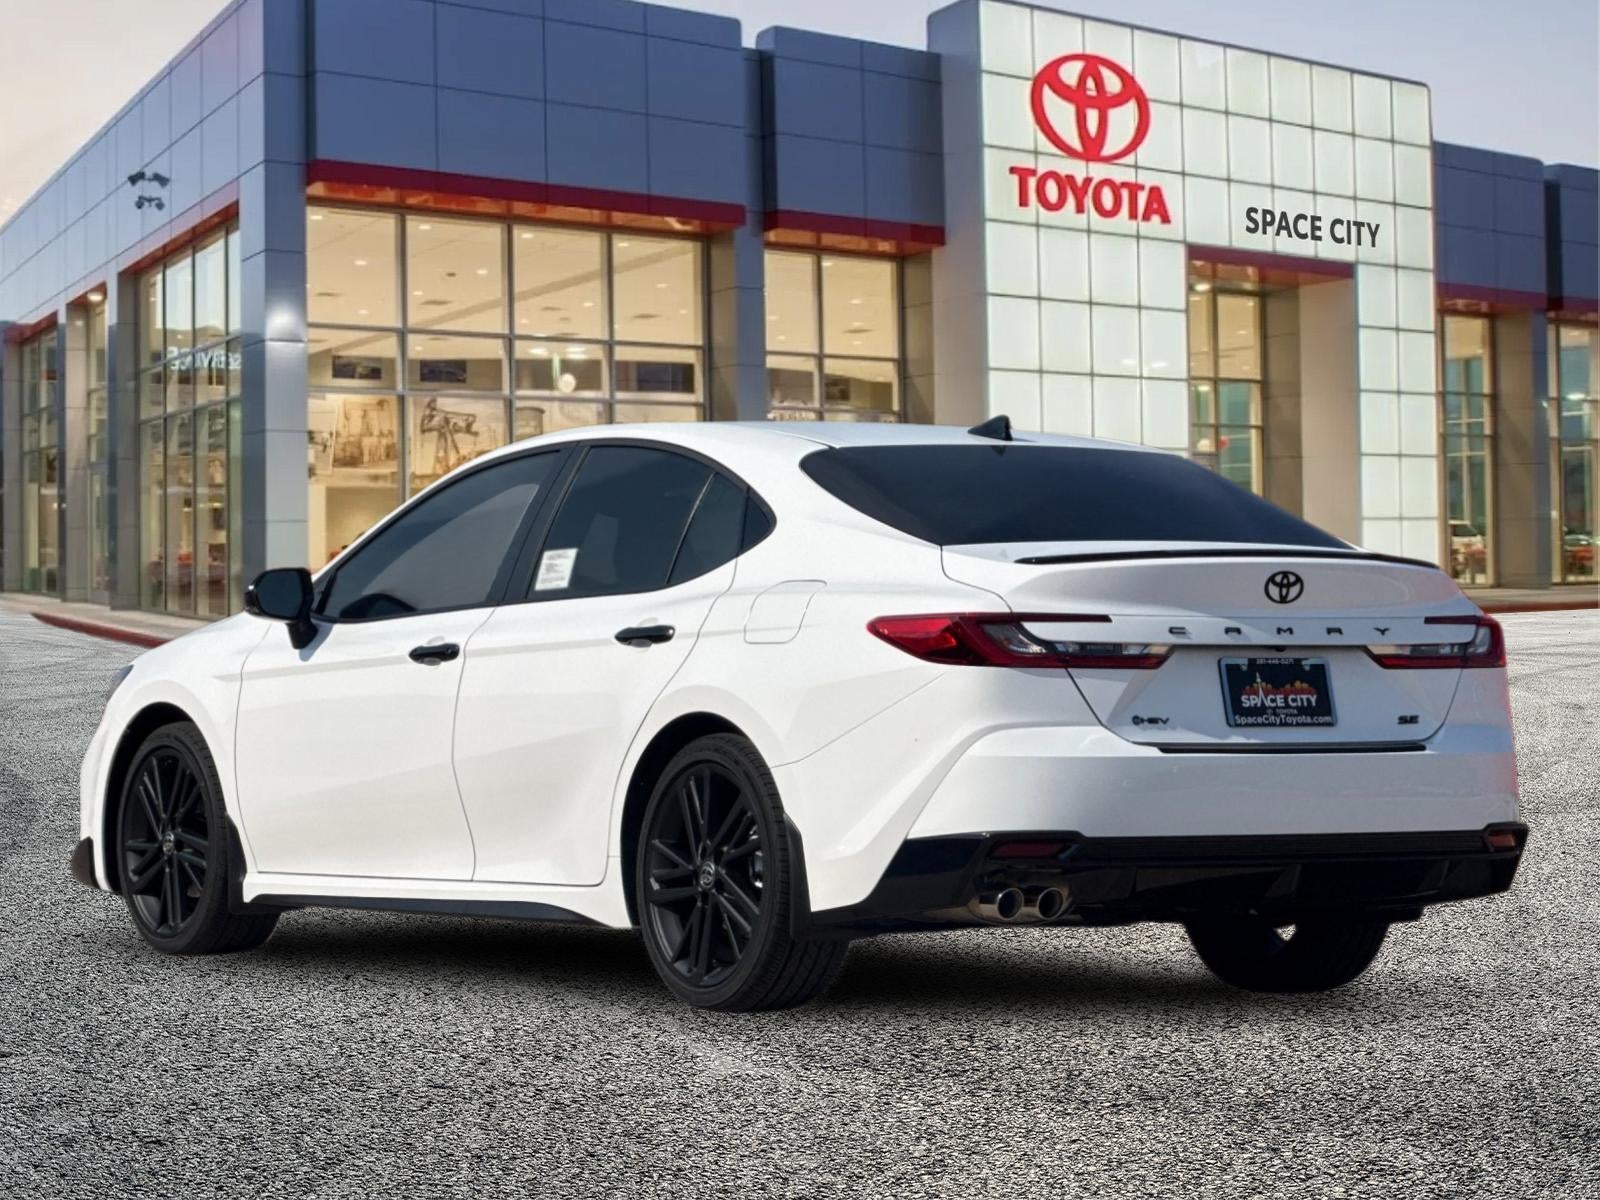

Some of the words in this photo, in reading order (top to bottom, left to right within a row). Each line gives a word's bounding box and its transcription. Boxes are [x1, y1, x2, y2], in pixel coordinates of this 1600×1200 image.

[1009, 166, 1171, 225] TOYOTA
[1245, 206, 1322, 242] SPACE
[1329, 218, 1381, 248] CITY
[1168, 626, 1391, 636] CAMRY
[1241, 694, 1285, 707] SPACE
[1288, 694, 1317, 707] CITY
[1234, 714, 1333, 725] SpaceCityToyota.com
[1397, 715, 1420, 725] SE
